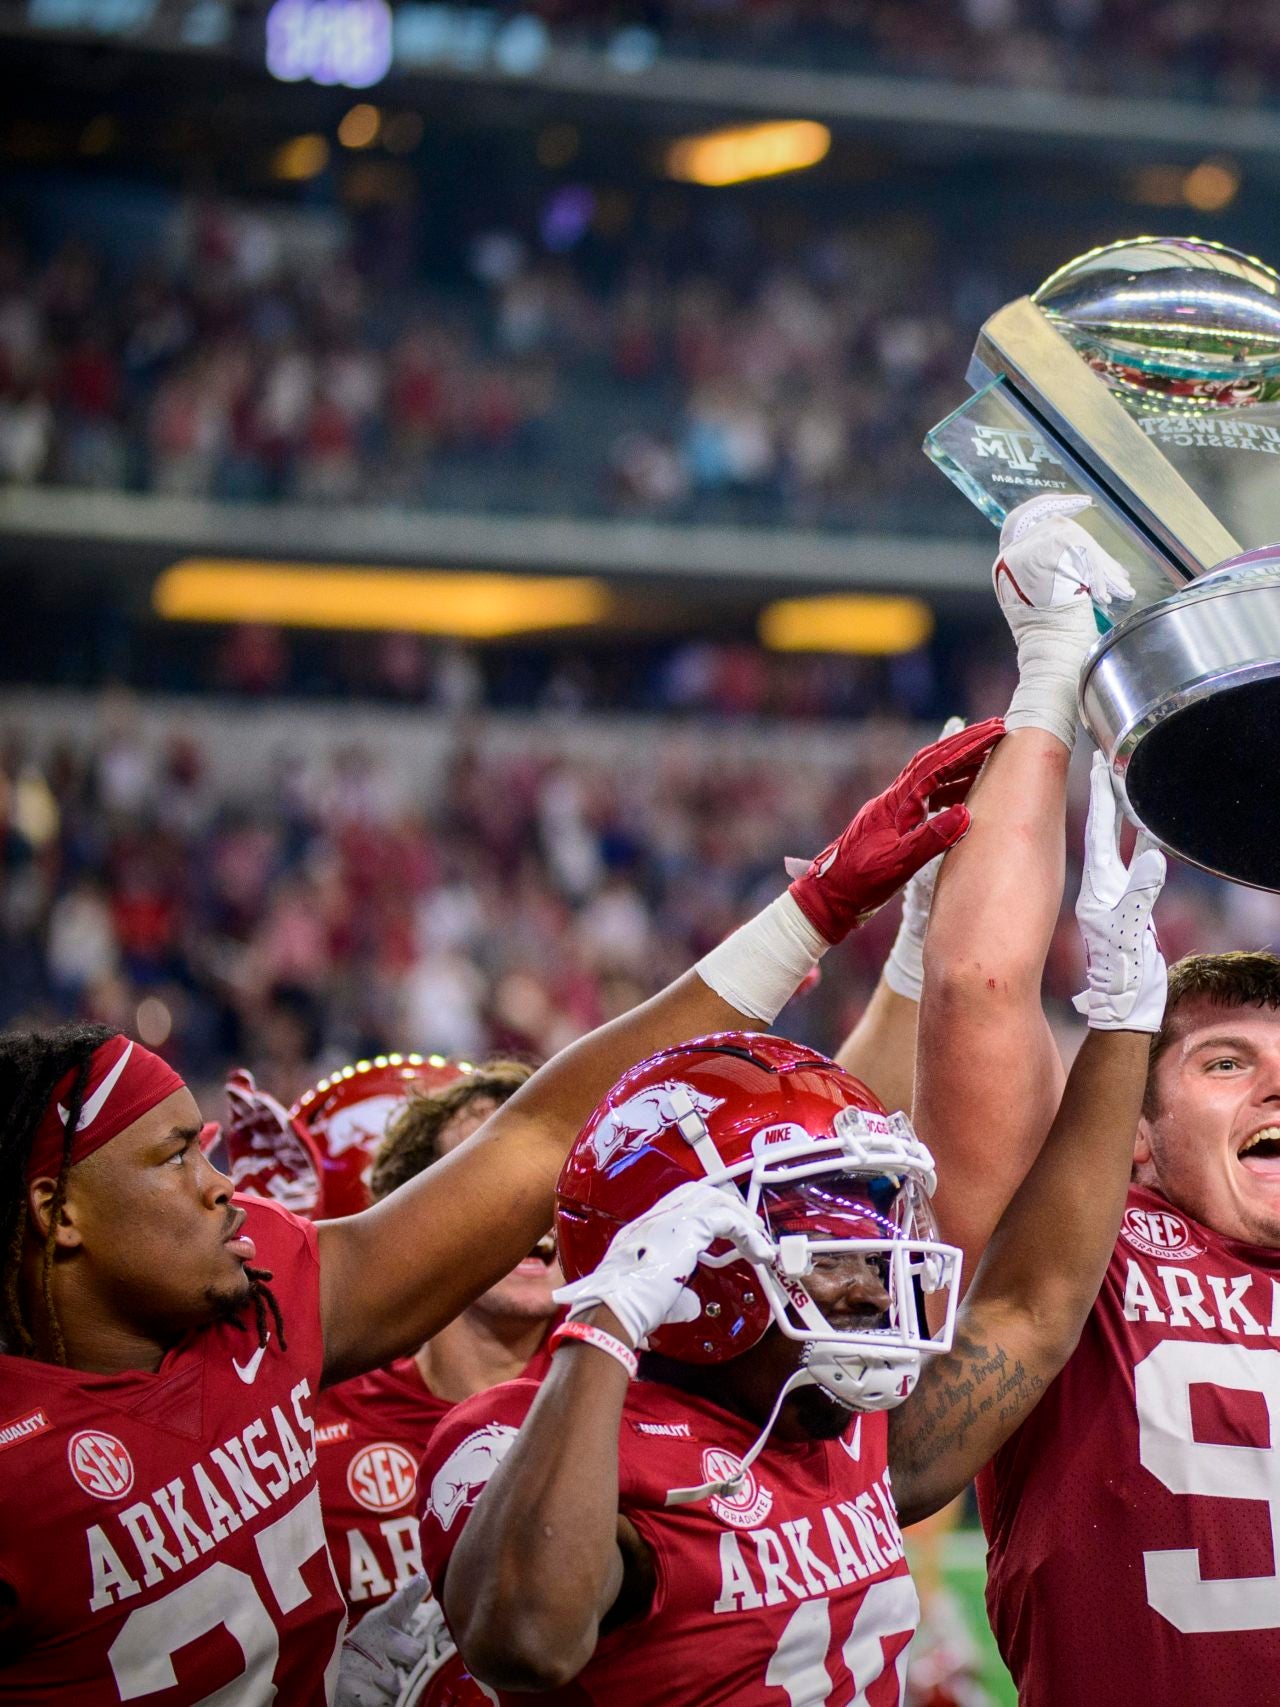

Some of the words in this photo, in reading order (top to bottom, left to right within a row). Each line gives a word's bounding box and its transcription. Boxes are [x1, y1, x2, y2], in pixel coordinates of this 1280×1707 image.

[764, 1127, 792, 1146] NIKE
[1129, 1210, 1183, 1248] SEC
[1129, 1238, 1192, 1258] GRADUATE
[637, 1422, 691, 1437] EQUALITY
[74, 1435, 129, 1494] SEC
[353, 1449, 414, 1507] SEC
[86, 1377, 318, 1613] ARKANSAS
[722, 1500, 769, 1526] GRADUATE
[713, 1466, 906, 1614] ARKANSA
